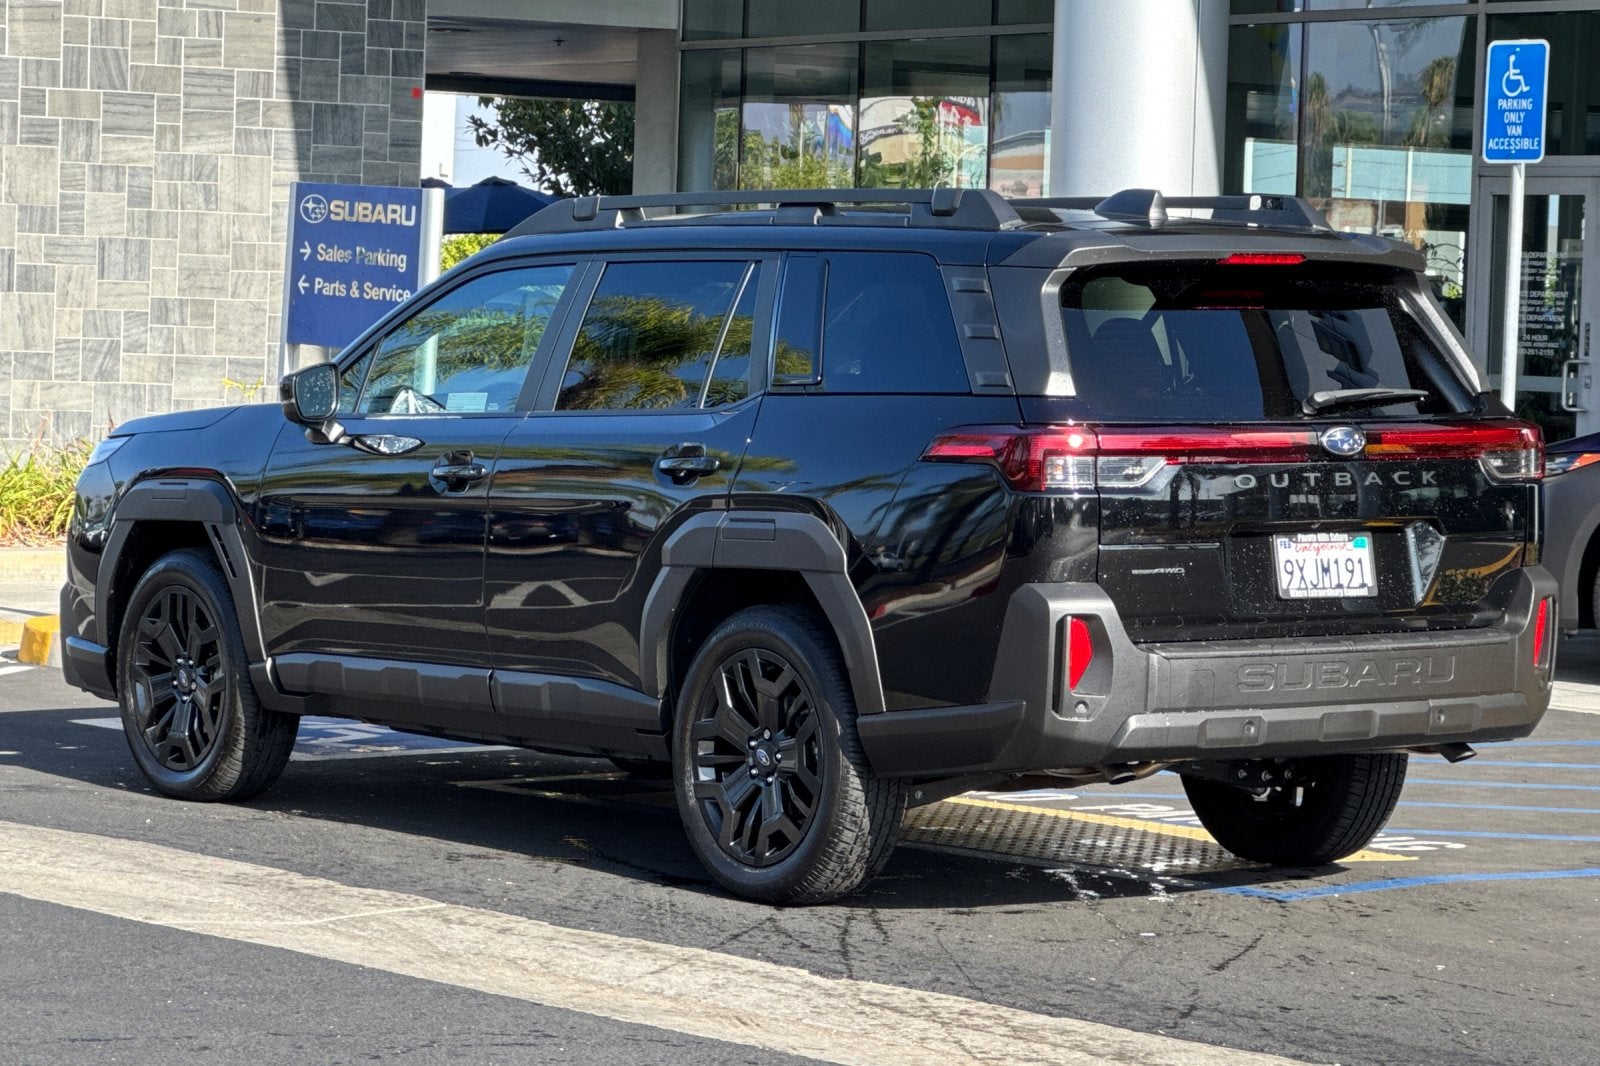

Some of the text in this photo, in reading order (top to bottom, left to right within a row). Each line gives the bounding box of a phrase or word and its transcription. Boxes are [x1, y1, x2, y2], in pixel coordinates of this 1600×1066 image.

[1497, 98, 1533, 110] PARKING
[1503, 111, 1525, 123] ONLY
[1506, 124, 1522, 136] VAN
[1487, 137, 1540, 150] ACCESSIBLE
[329, 199, 416, 227] SUBARU
[317, 243, 407, 273] Sales Parking
[314, 277, 411, 302] Parts & Service
[1234, 470, 1438, 489] OUTBACK
[1284, 557, 1367, 590] 9XJM191
[1237, 655, 1456, 693] SUBARU
